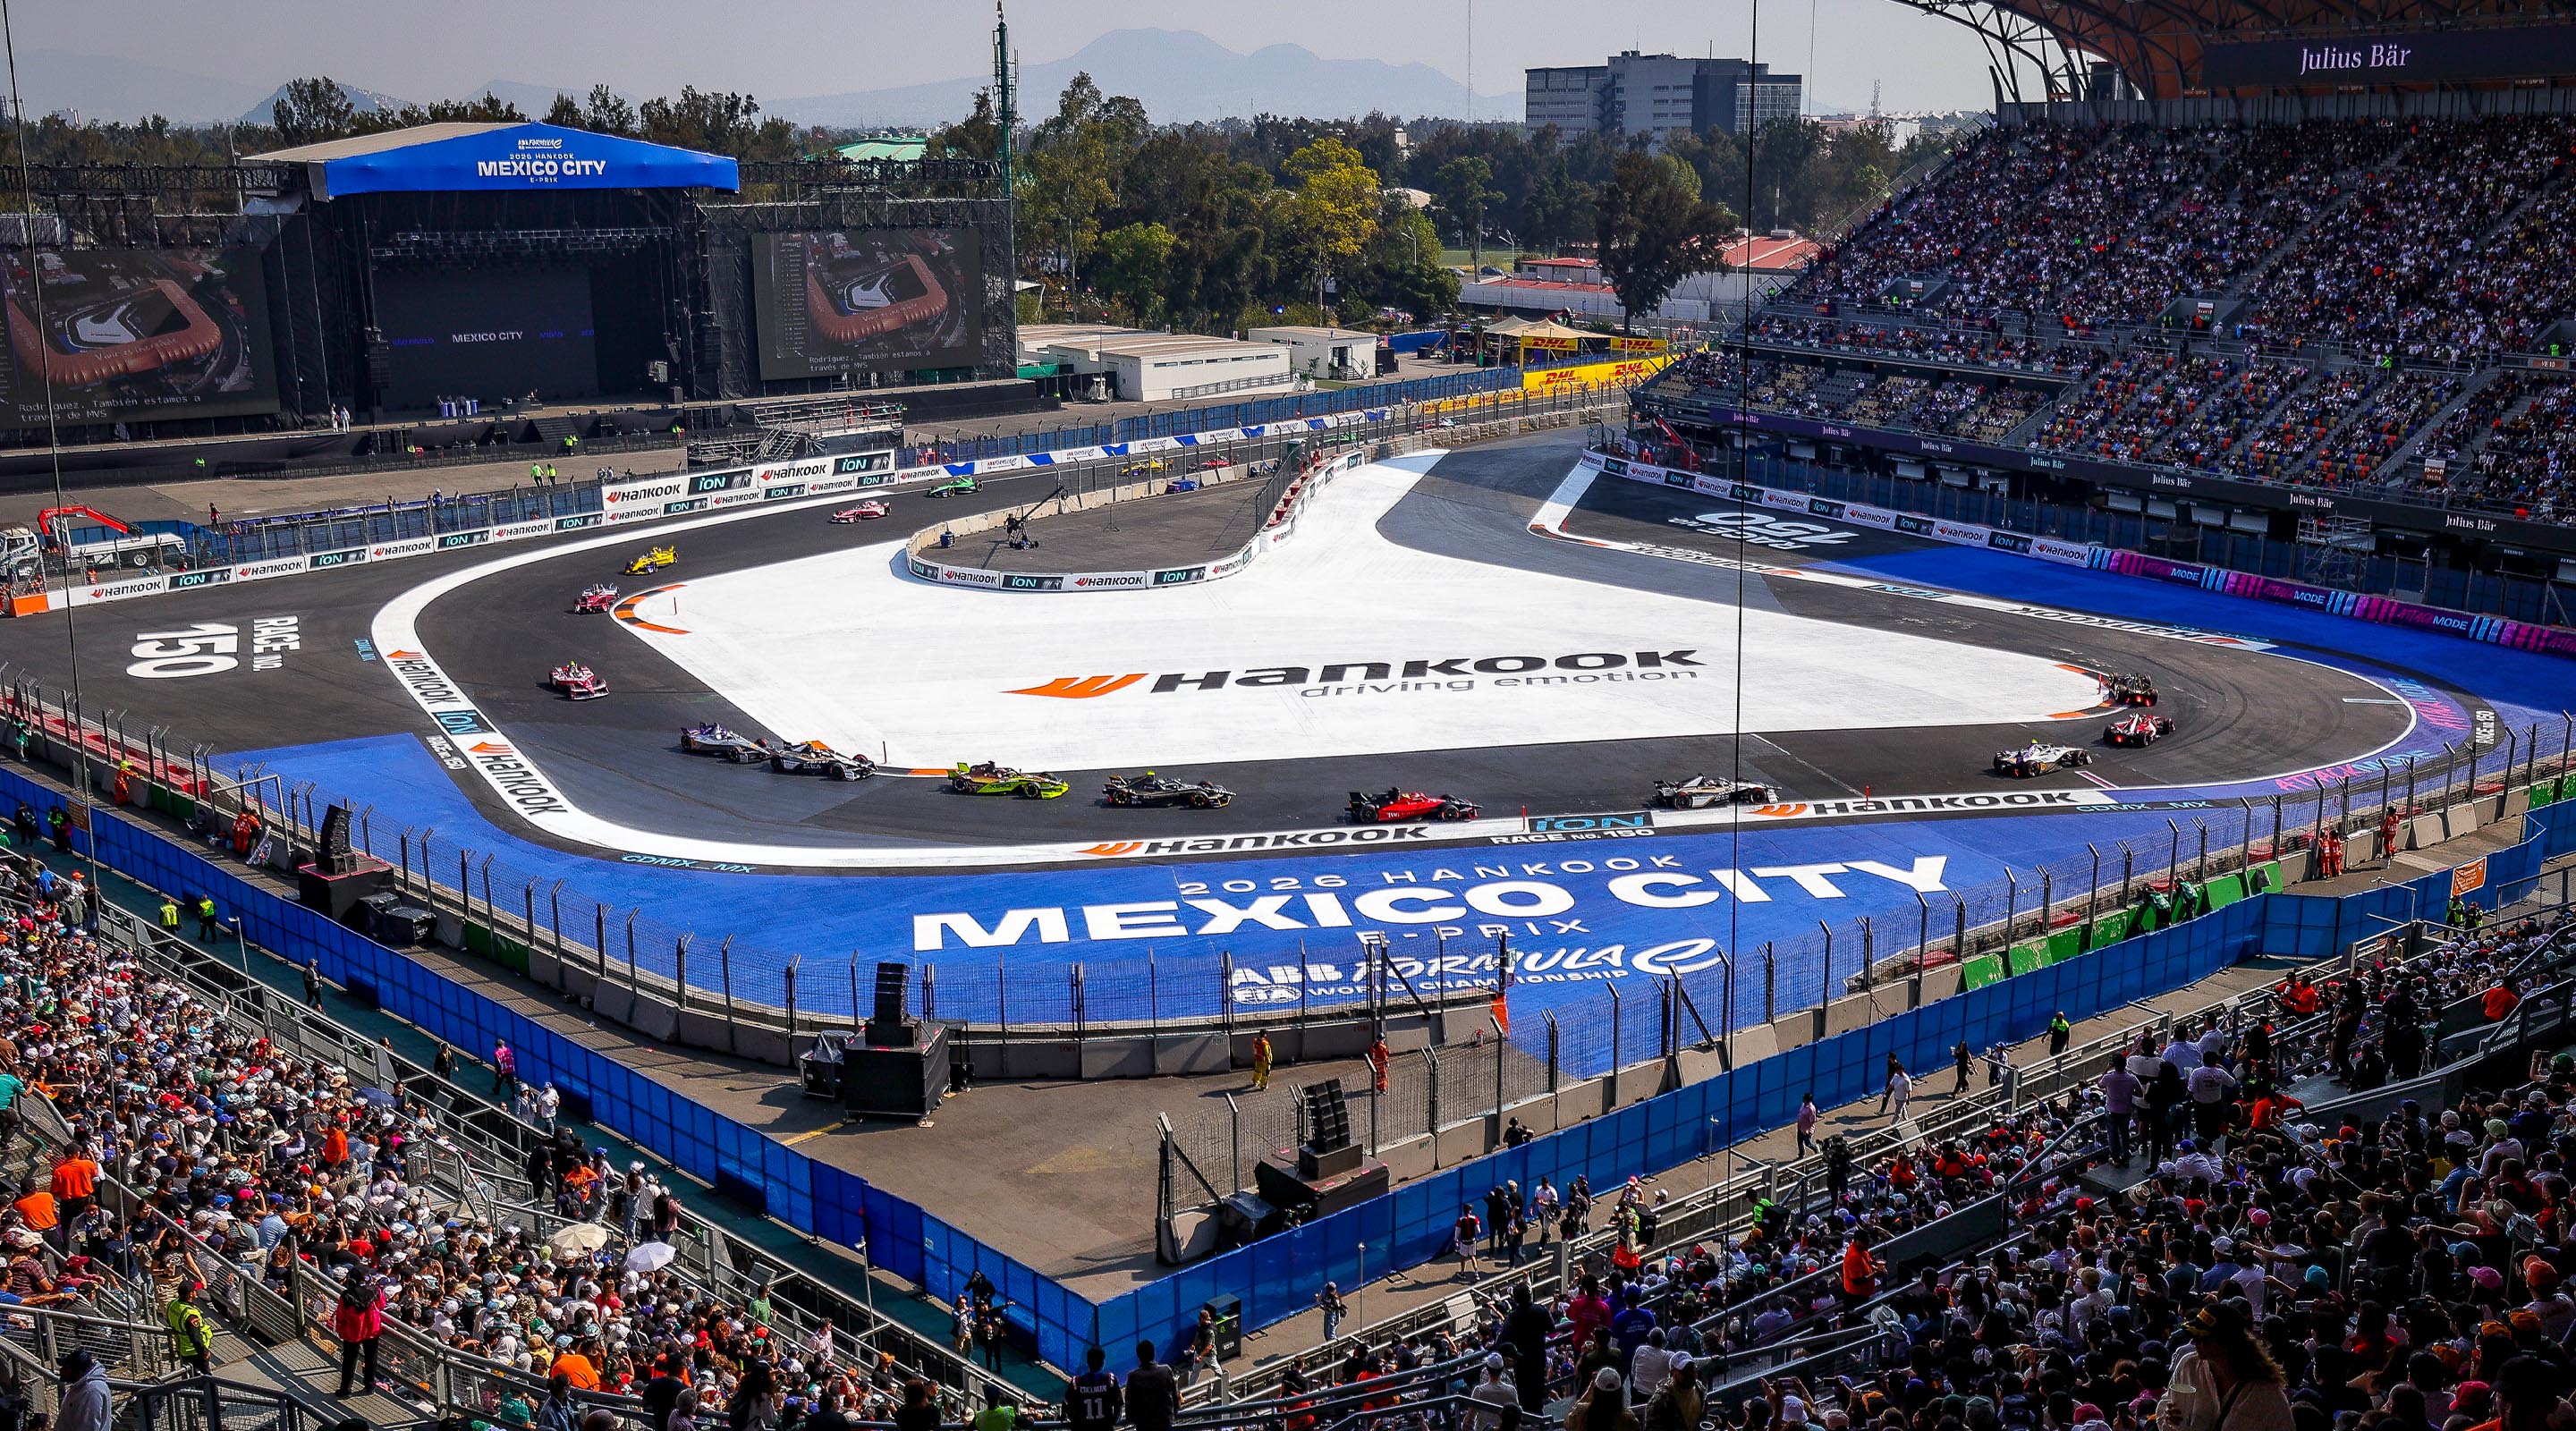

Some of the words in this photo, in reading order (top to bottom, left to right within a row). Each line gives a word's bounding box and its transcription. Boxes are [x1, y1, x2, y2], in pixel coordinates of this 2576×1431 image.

[2300, 47, 2362, 75] Julius
[2368, 44, 2411, 68] Bär
[478, 161, 559, 176] MEXICO
[562, 160, 606, 175] CITY
[453, 333, 496, 343] MEXICO
[499, 331, 523, 341] CITY
[1532, 337, 1569, 349] DHL
[1619, 339, 1660, 350] DHL
[809, 363, 838, 372] través
[1614, 362, 1644, 377] DHL
[1545, 369, 1577, 385] DHL
[19, 401, 85, 413] Rodrguez.
[144, 395, 188, 405] estamos
[67, 411, 81, 419] de
[87, 410, 107, 419] MVS
[1733, 411, 1750, 422] Julis
[1750, 414, 1760, 424] Bär
[1822, 425, 1841, 436] Julius
[1842, 428, 1852, 437] Bär
[1921, 441, 1940, 451] Julius
[1941, 443, 1953, 453] Bär
[2030, 455, 2050, 469] Julius
[2052, 458, 2066, 470] Bär
[2152, 474, 2175, 486] Julius
[2177, 477, 2192, 488] Bär
[2289, 492, 2316, 507] Julius
[2318, 495, 2334, 509] Bär
[1696, 512, 1860, 545] 150
[2445, 513, 2476, 530] Julius
[2478, 517, 2497, 533] Bär
[1696, 526, 1811, 550] RACE
[2171, 568, 2200, 581] MODE
[2294, 590, 2326, 605] MODE
[2433, 614, 2469, 631] MODE
[253, 614, 301, 654] RACE
[125, 622, 240, 679] 150
[1300, 674, 1476, 699] driving
[1493, 669, 1699, 692] emotion
[1489, 833, 1564, 844] RACE
[1608, 827, 1656, 838] 150
[1179, 874, 1349, 895] 2026
[1382, 854, 1683, 884] HANKOOK
[913, 880, 1575, 953] MEXICO
[1608, 855, 1951, 910] CITY
[1230, 962, 1343, 985] ABB
[1354, 944, 1627, 981] FORMULA
[1419, 970, 1630, 990] CHAMIONSHIP
[1083, 1397, 1106, 1420] 11
